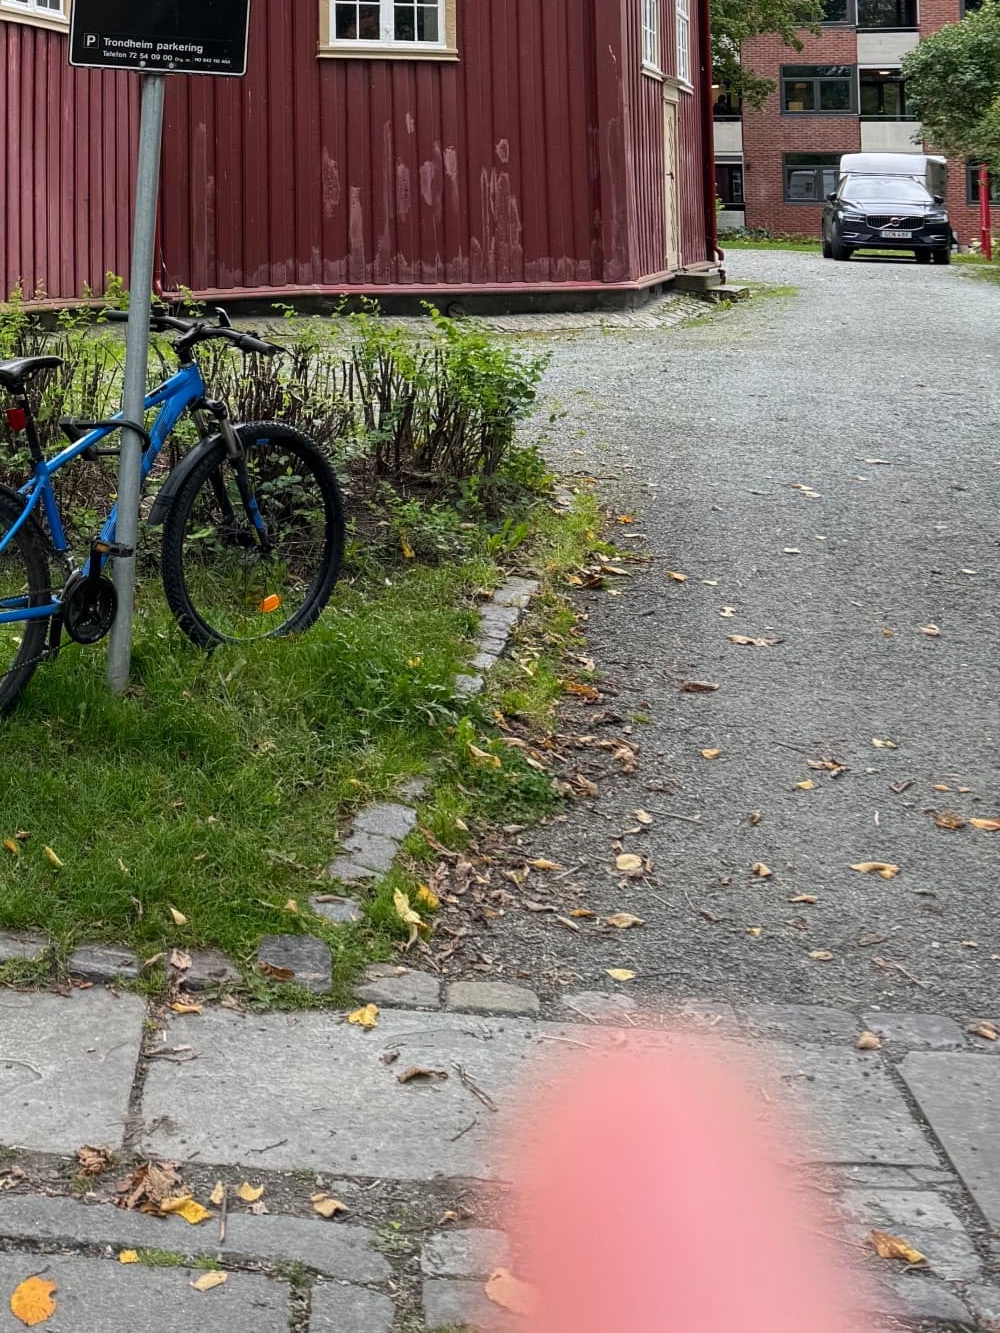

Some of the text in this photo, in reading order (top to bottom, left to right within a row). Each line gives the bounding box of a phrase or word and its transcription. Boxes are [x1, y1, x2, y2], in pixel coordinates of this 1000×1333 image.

[86, 35, 96, 46] P
[103, 37, 204, 54] Trondheim parkering
[103, 50, 127, 58] Telefon
[129, 51, 137, 59] 72
